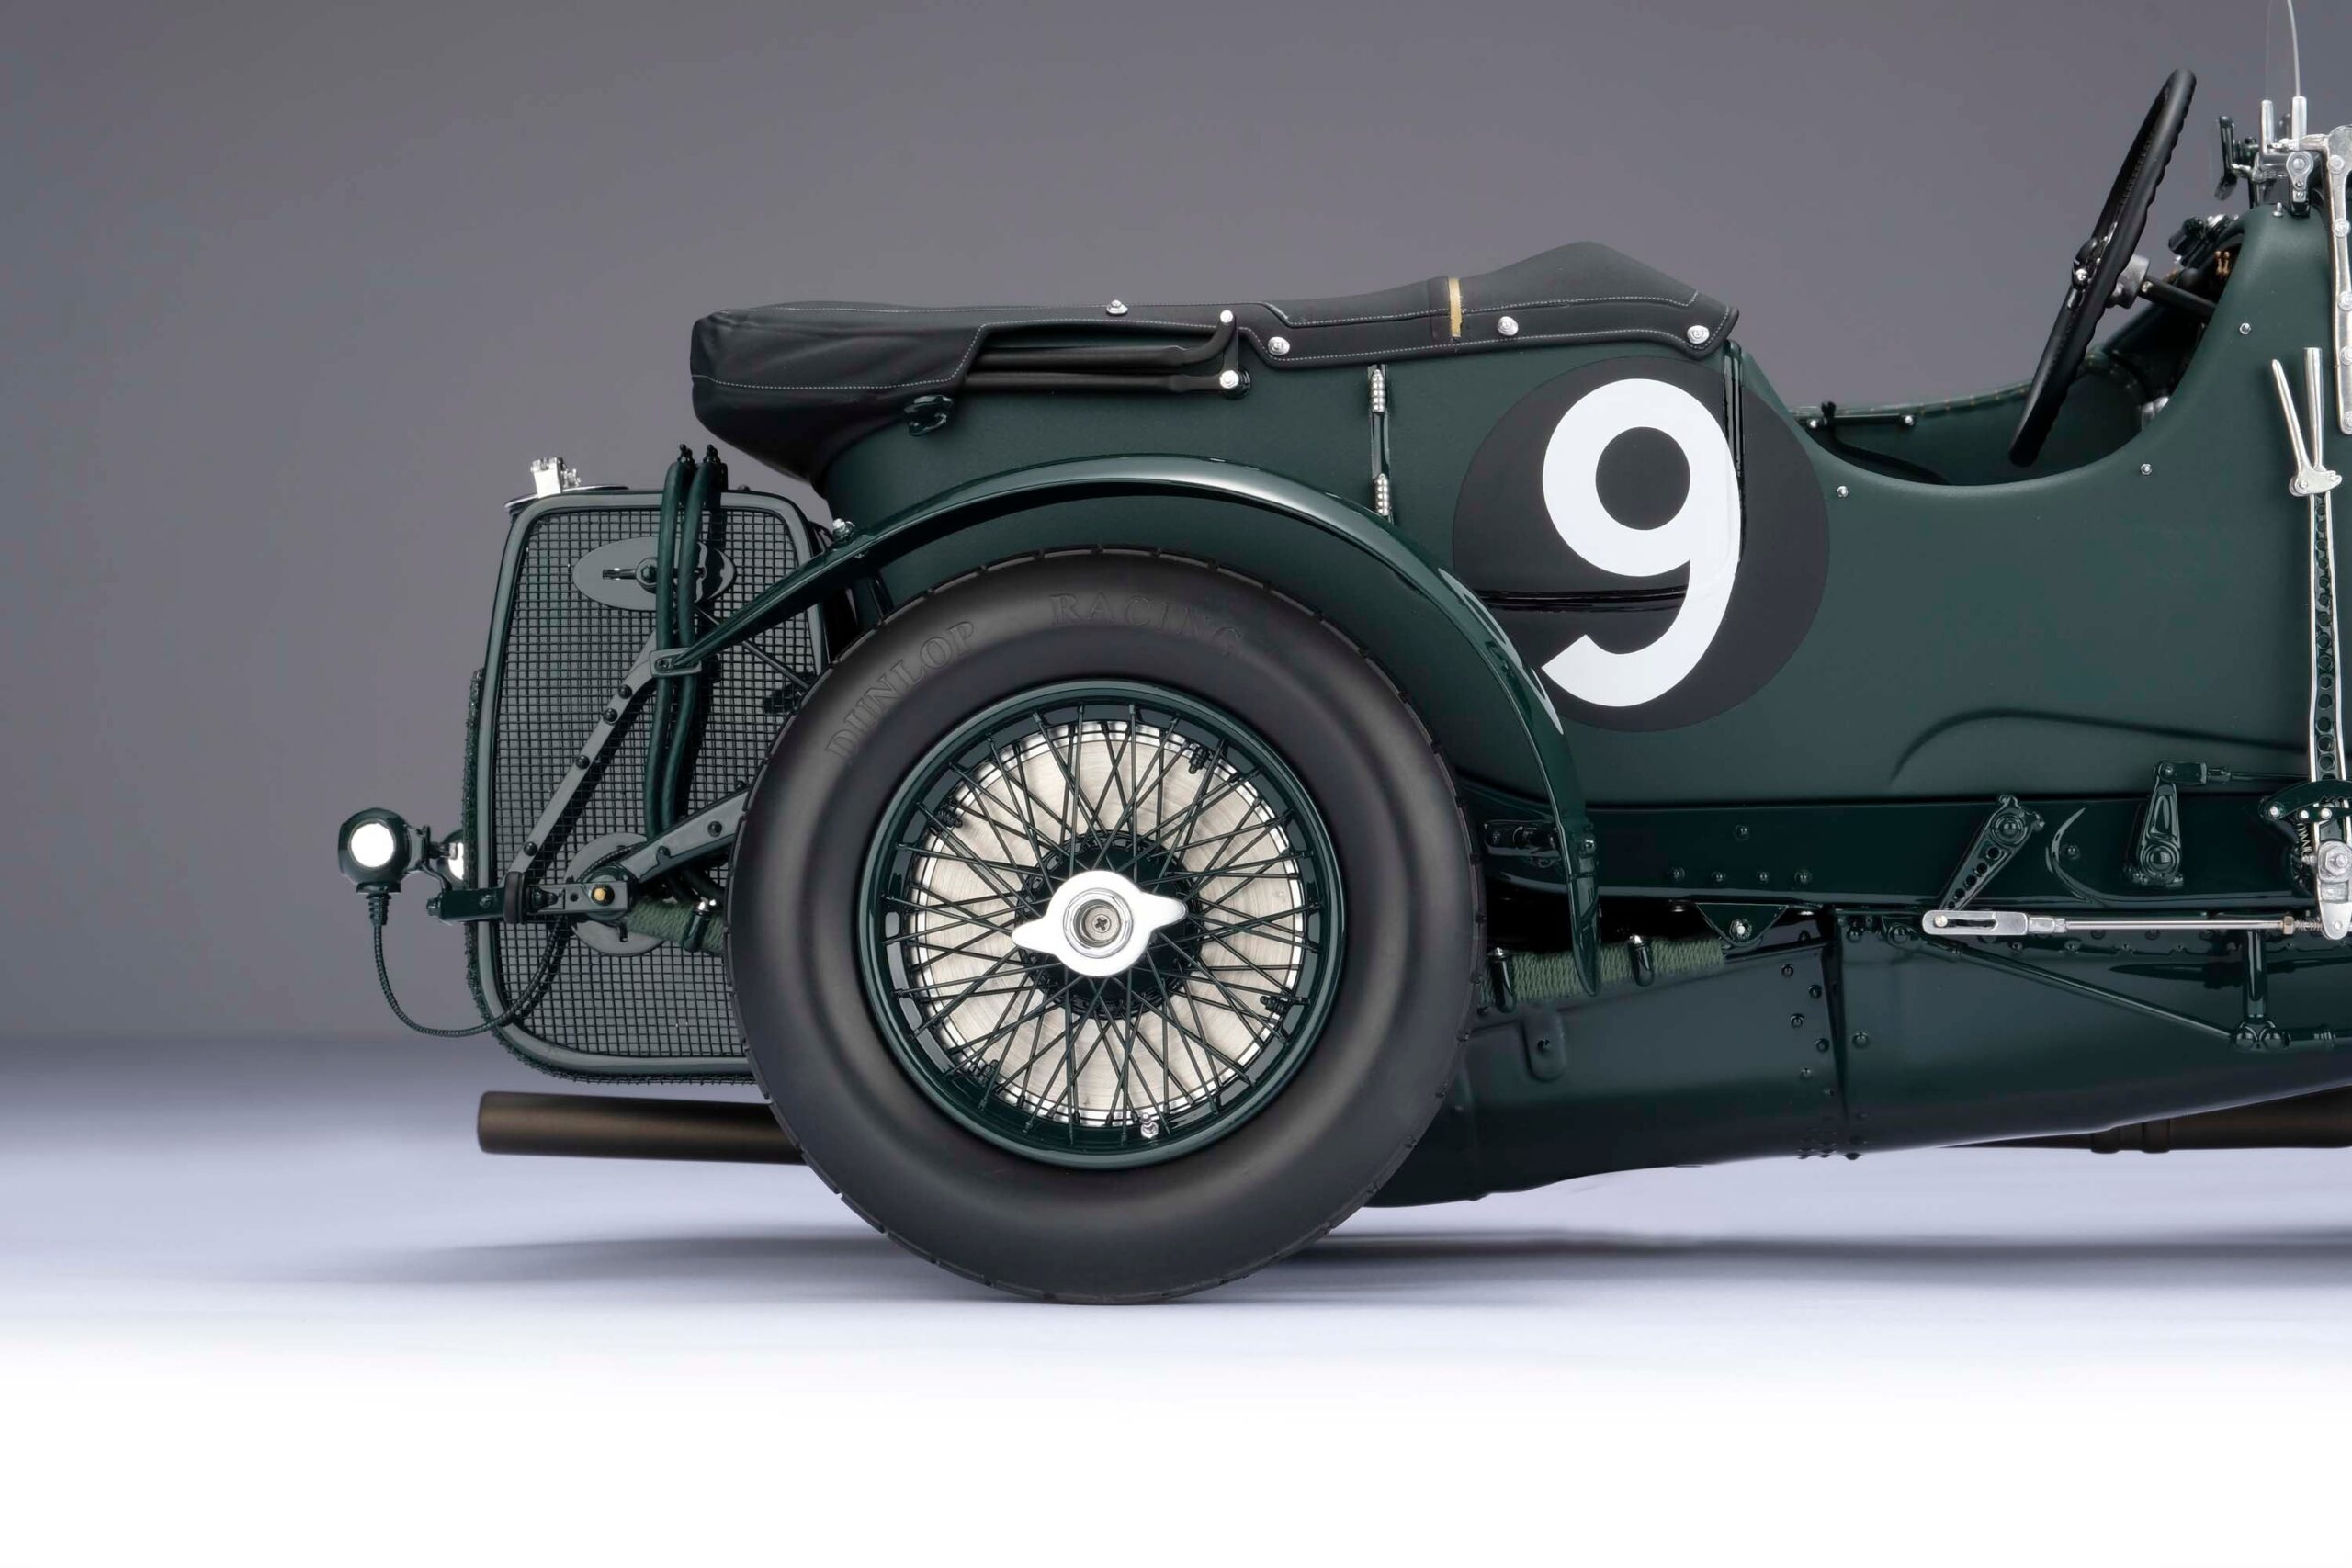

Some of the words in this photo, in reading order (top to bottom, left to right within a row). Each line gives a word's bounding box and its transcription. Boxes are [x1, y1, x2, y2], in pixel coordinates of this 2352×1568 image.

[1542, 378, 1742, 707] 9
[825, 620, 978, 761] DUNLOP
[1049, 591, 1245, 657] RACING
